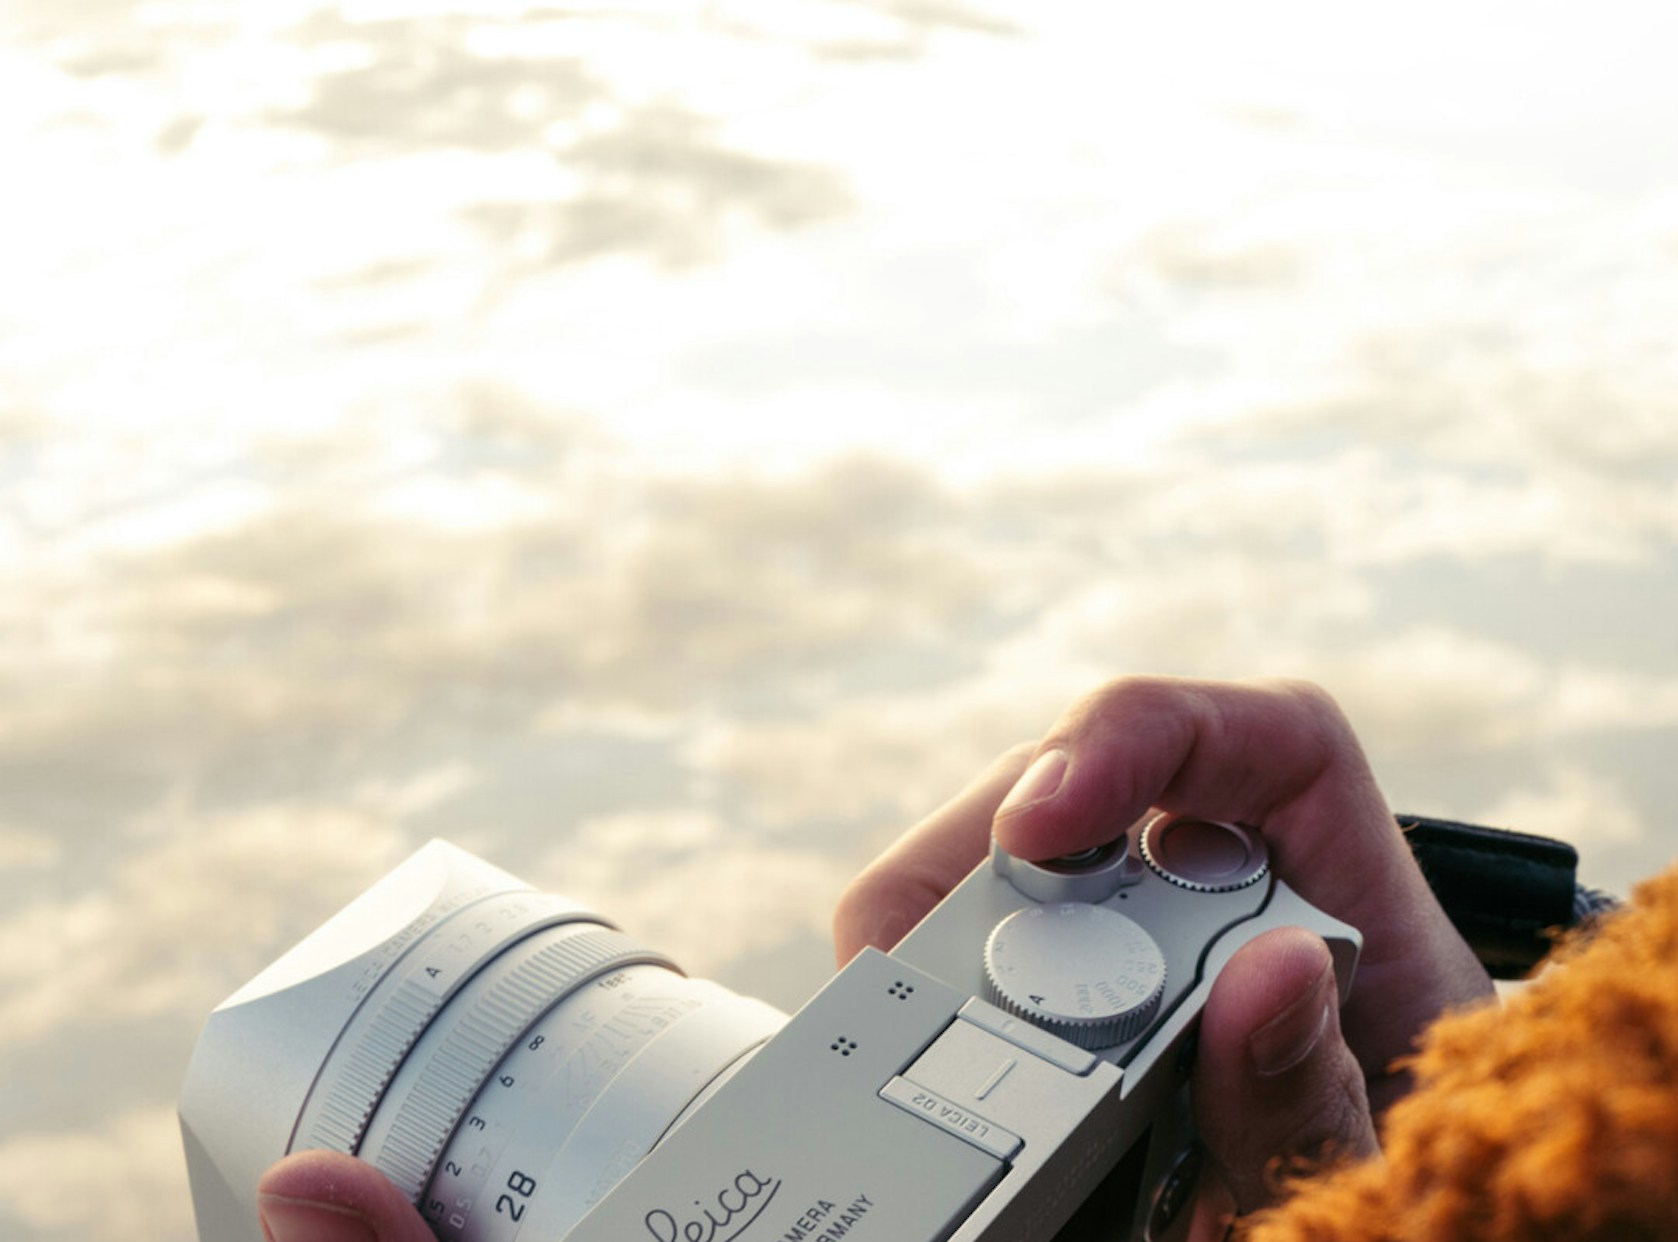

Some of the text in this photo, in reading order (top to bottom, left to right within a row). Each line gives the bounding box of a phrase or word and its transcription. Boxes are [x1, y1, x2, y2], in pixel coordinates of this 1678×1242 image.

[425, 966, 442, 979] A
[1028, 994, 1046, 1006] A
[469, 1117, 487, 1132] 3
[940, 1106, 990, 1138] LEICA
[445, 1161, 462, 1177] 2
[496, 1170, 537, 1223] 28
